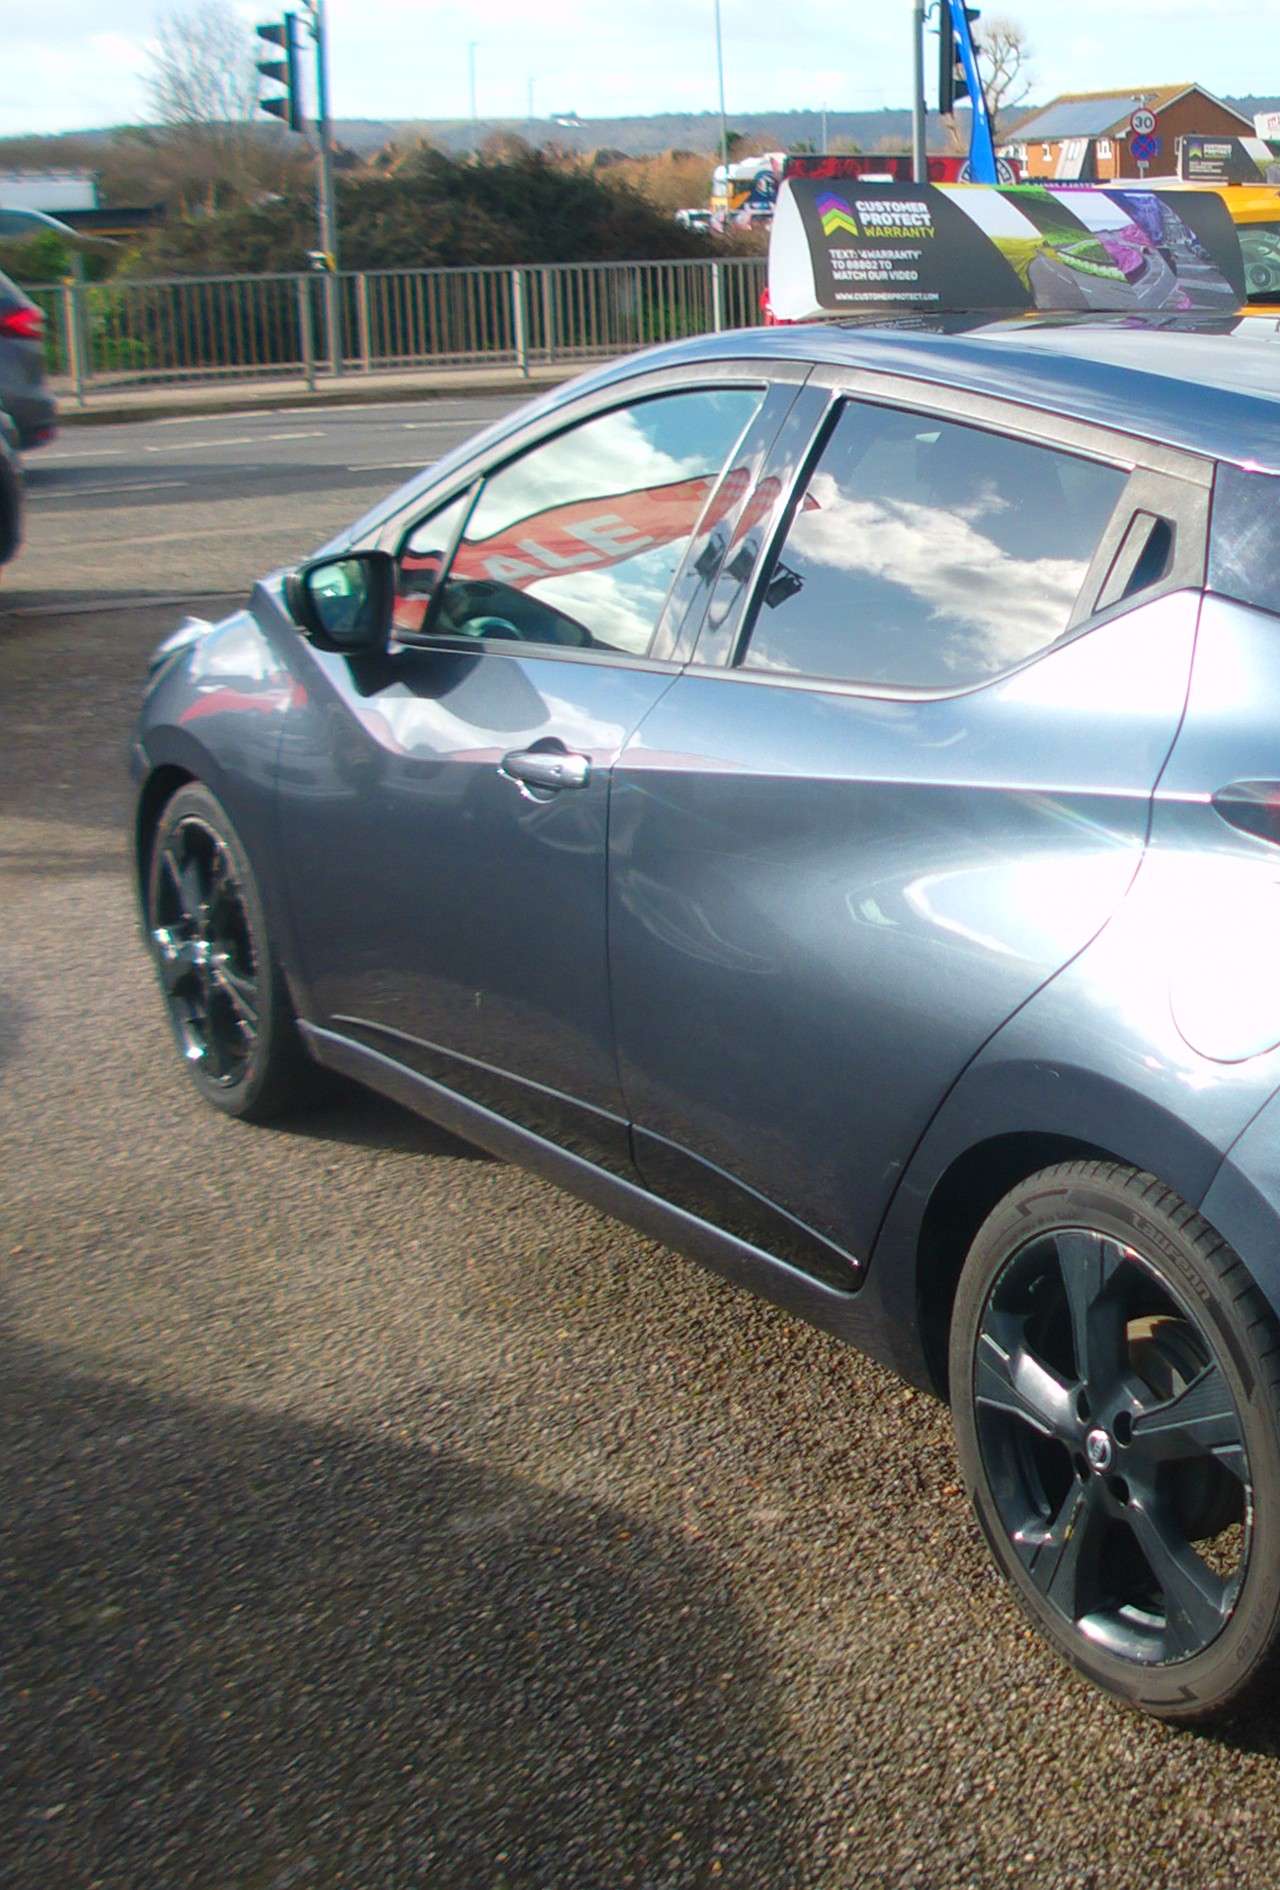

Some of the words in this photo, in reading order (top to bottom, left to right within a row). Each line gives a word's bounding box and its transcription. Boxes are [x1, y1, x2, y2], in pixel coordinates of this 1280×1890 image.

[1135, 115, 1153, 129] 30
[855, 200, 930, 213] CUSTOMER
[859, 212, 933, 226] PROTECT
[864, 226, 935, 238] WARRANTY
[831, 260, 845, 269] TO
[879, 260, 893, 270] TO
[832, 270, 866, 280] WATCH
[868, 270, 888, 280] OUR
[890, 271, 918, 280] VIDEO
